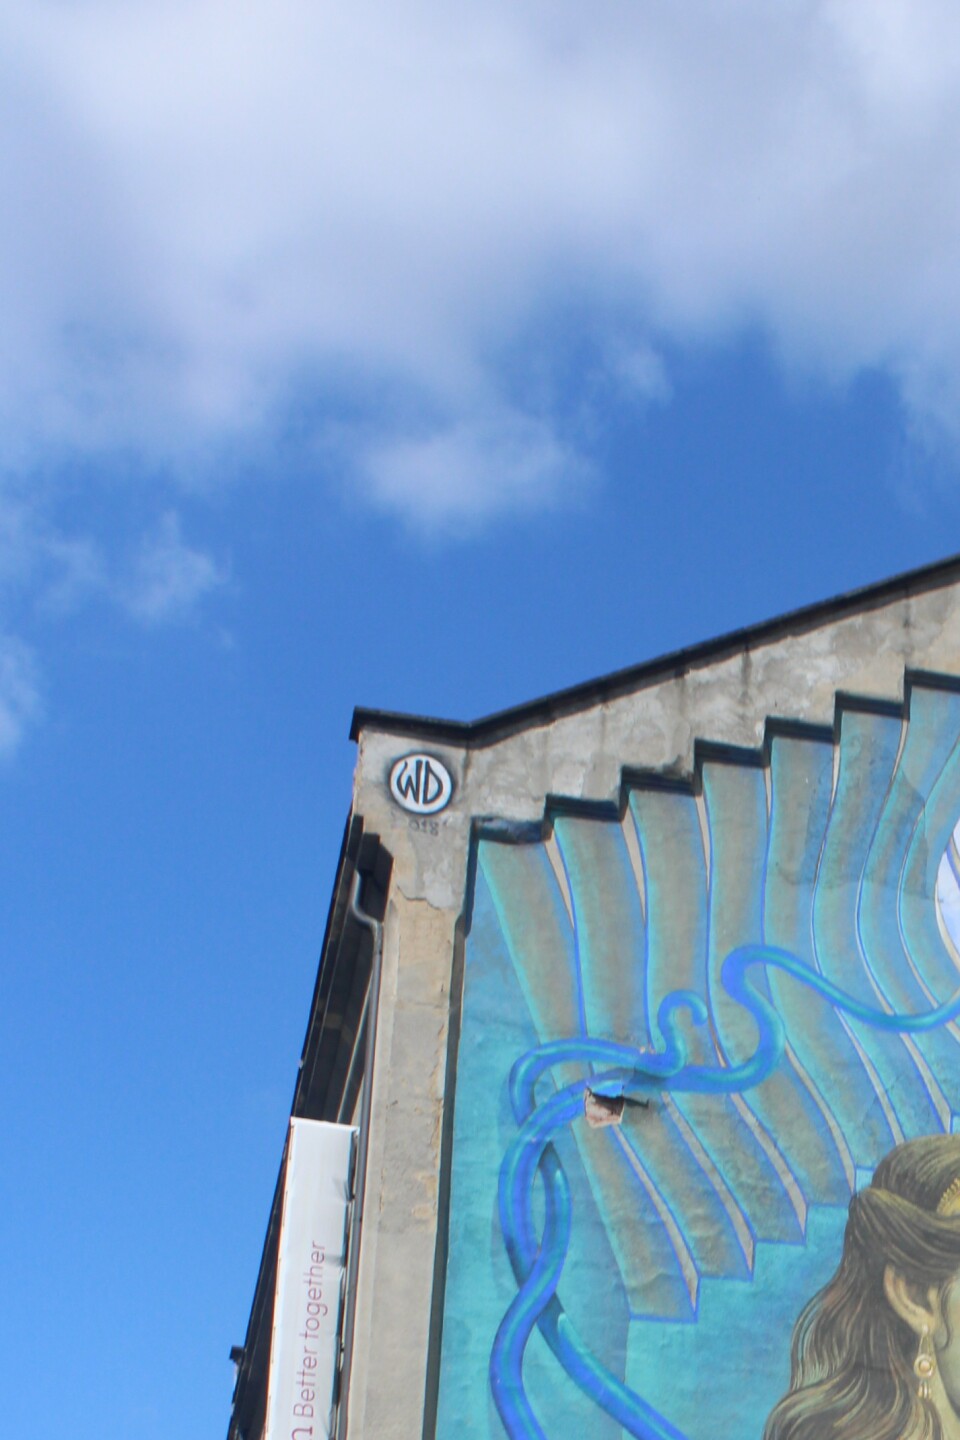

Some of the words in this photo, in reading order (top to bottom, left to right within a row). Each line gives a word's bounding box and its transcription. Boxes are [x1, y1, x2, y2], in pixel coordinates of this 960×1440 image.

[396, 758, 444, 805] WD
[299, 1240, 328, 1340] together
[293, 1346, 319, 1418] Better
